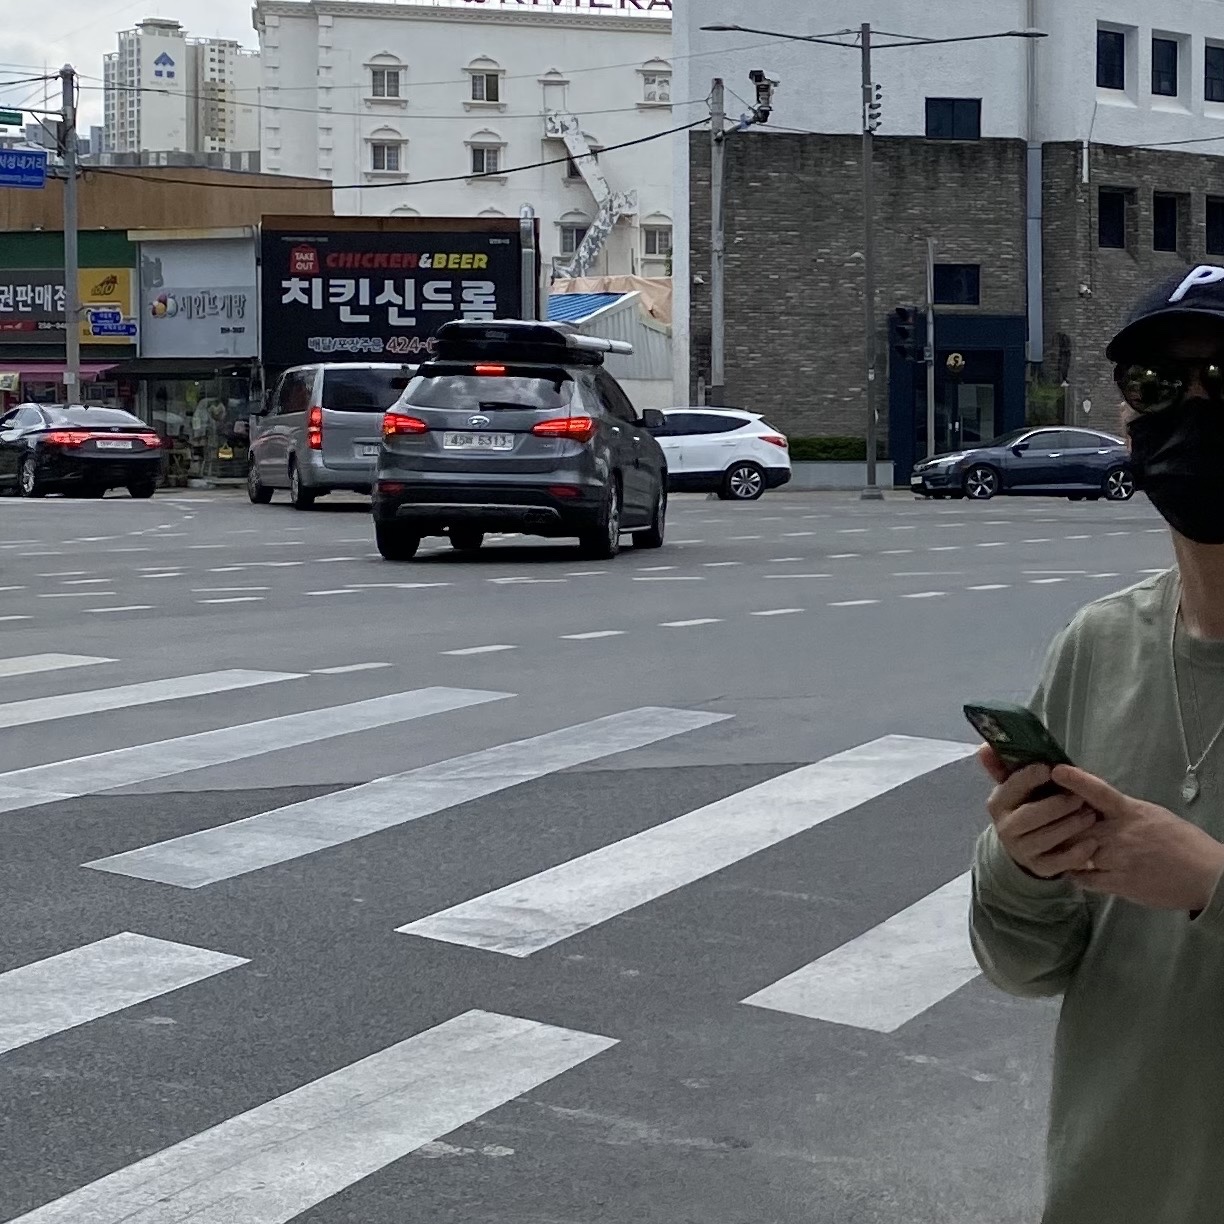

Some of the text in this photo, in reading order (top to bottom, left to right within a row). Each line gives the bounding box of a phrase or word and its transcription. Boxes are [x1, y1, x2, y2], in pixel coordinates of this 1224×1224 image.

[295, 252, 315, 262] TAKE
[295, 261, 314, 271] OUT
[281, 277, 497, 326] 치킨신드롬
